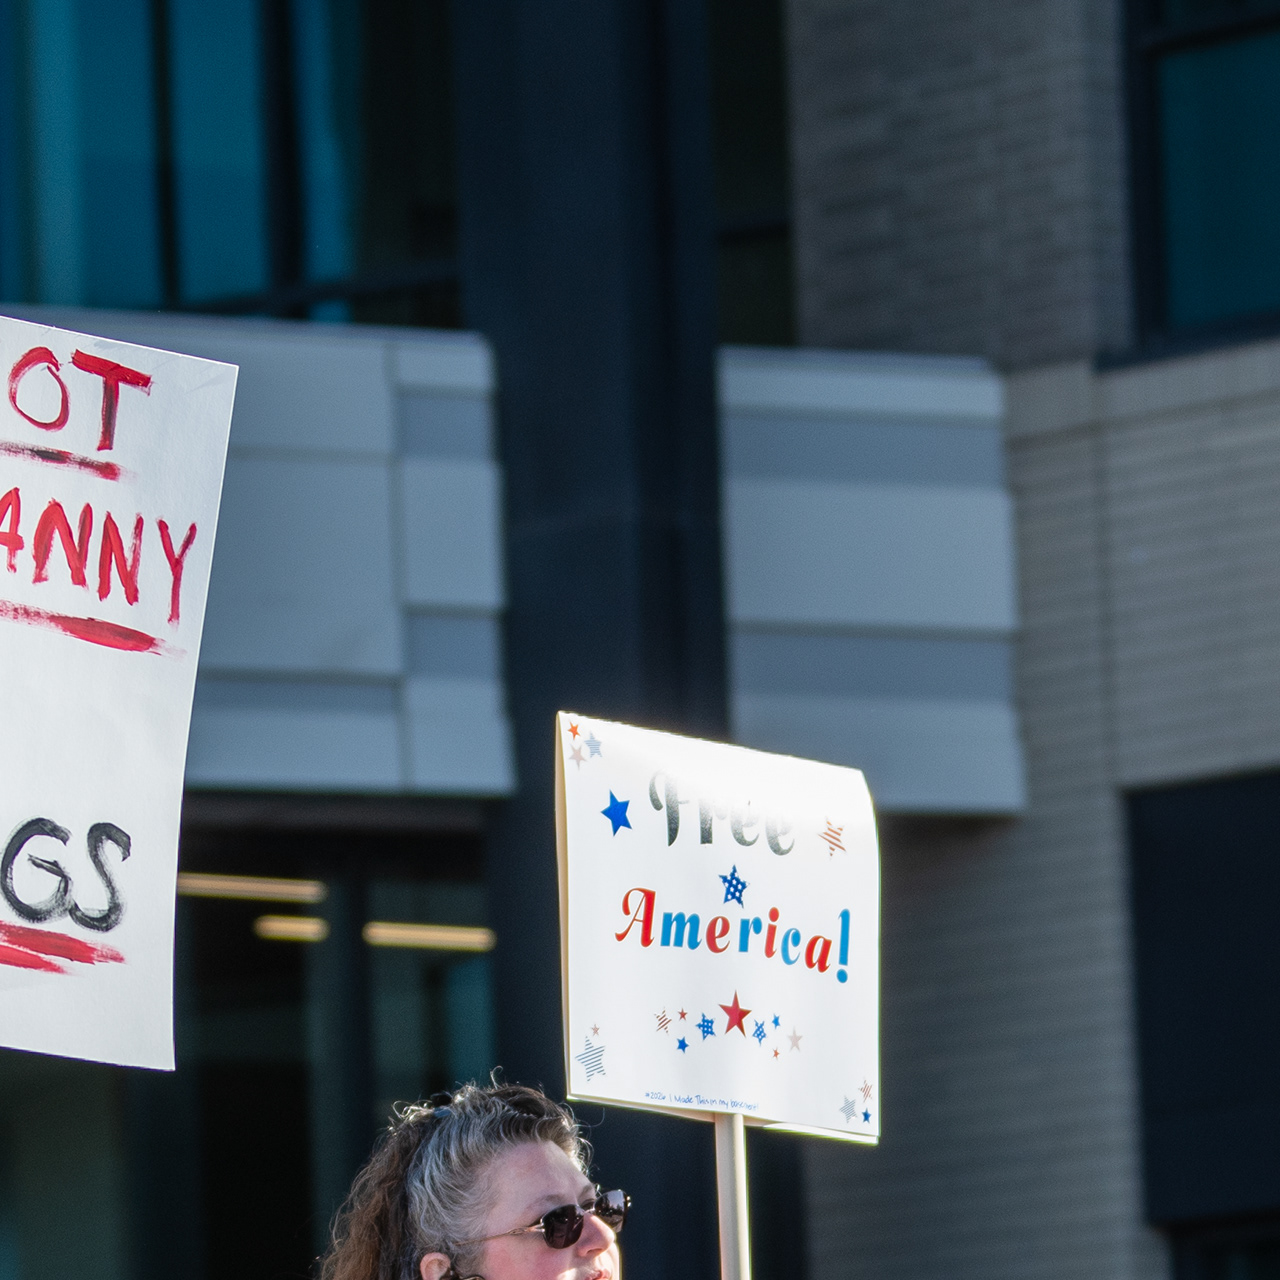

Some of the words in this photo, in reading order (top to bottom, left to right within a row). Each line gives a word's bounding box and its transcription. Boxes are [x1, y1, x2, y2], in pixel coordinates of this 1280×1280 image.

[615, 888, 851, 983] America!
[674, 1095, 693, 1104] Made
[694, 1094, 710, 1105] This
